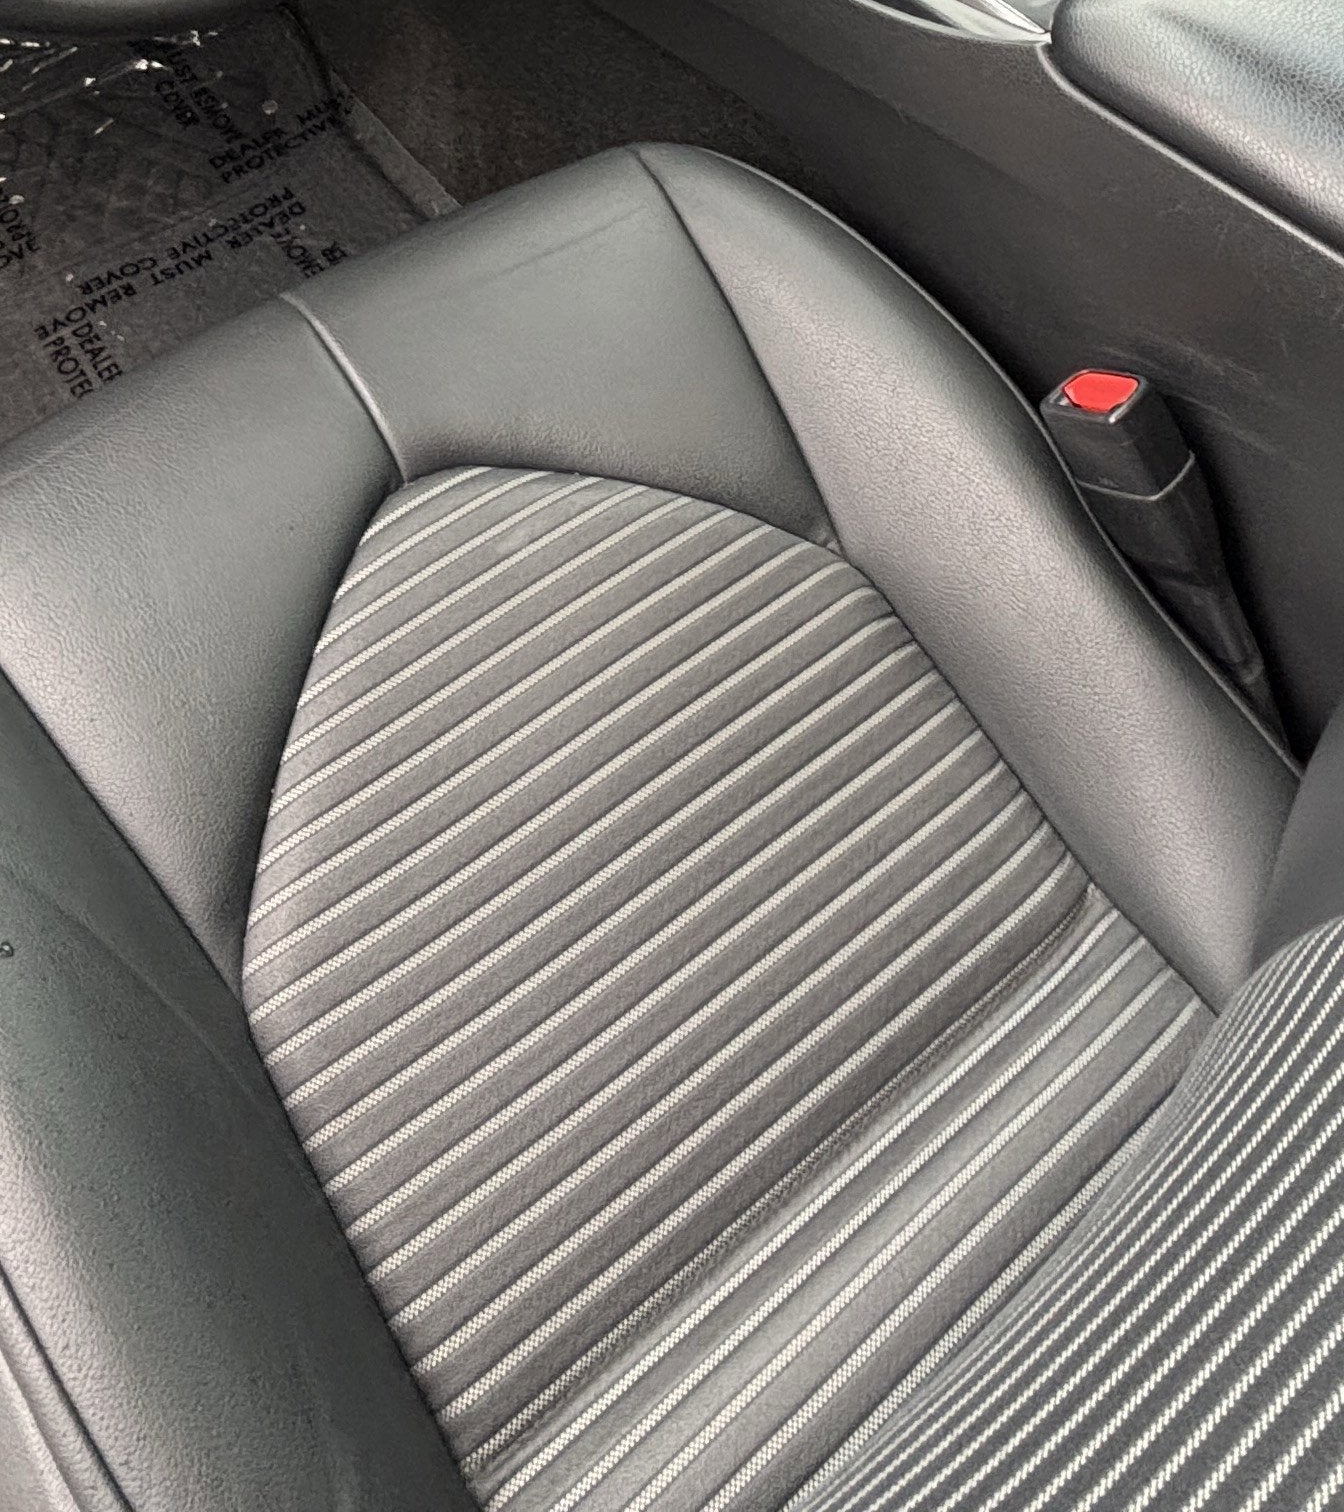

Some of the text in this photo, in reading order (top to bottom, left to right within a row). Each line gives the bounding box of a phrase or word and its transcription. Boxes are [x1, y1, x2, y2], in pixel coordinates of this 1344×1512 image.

[208, 127, 287, 170] DEALER
[167, 186, 295, 261] PROTECTIVE
[35, 201, 306, 341] DEALER MUST REMOVE
[77, 254, 159, 296] COVER
[42, 338, 94, 402] PROTE
